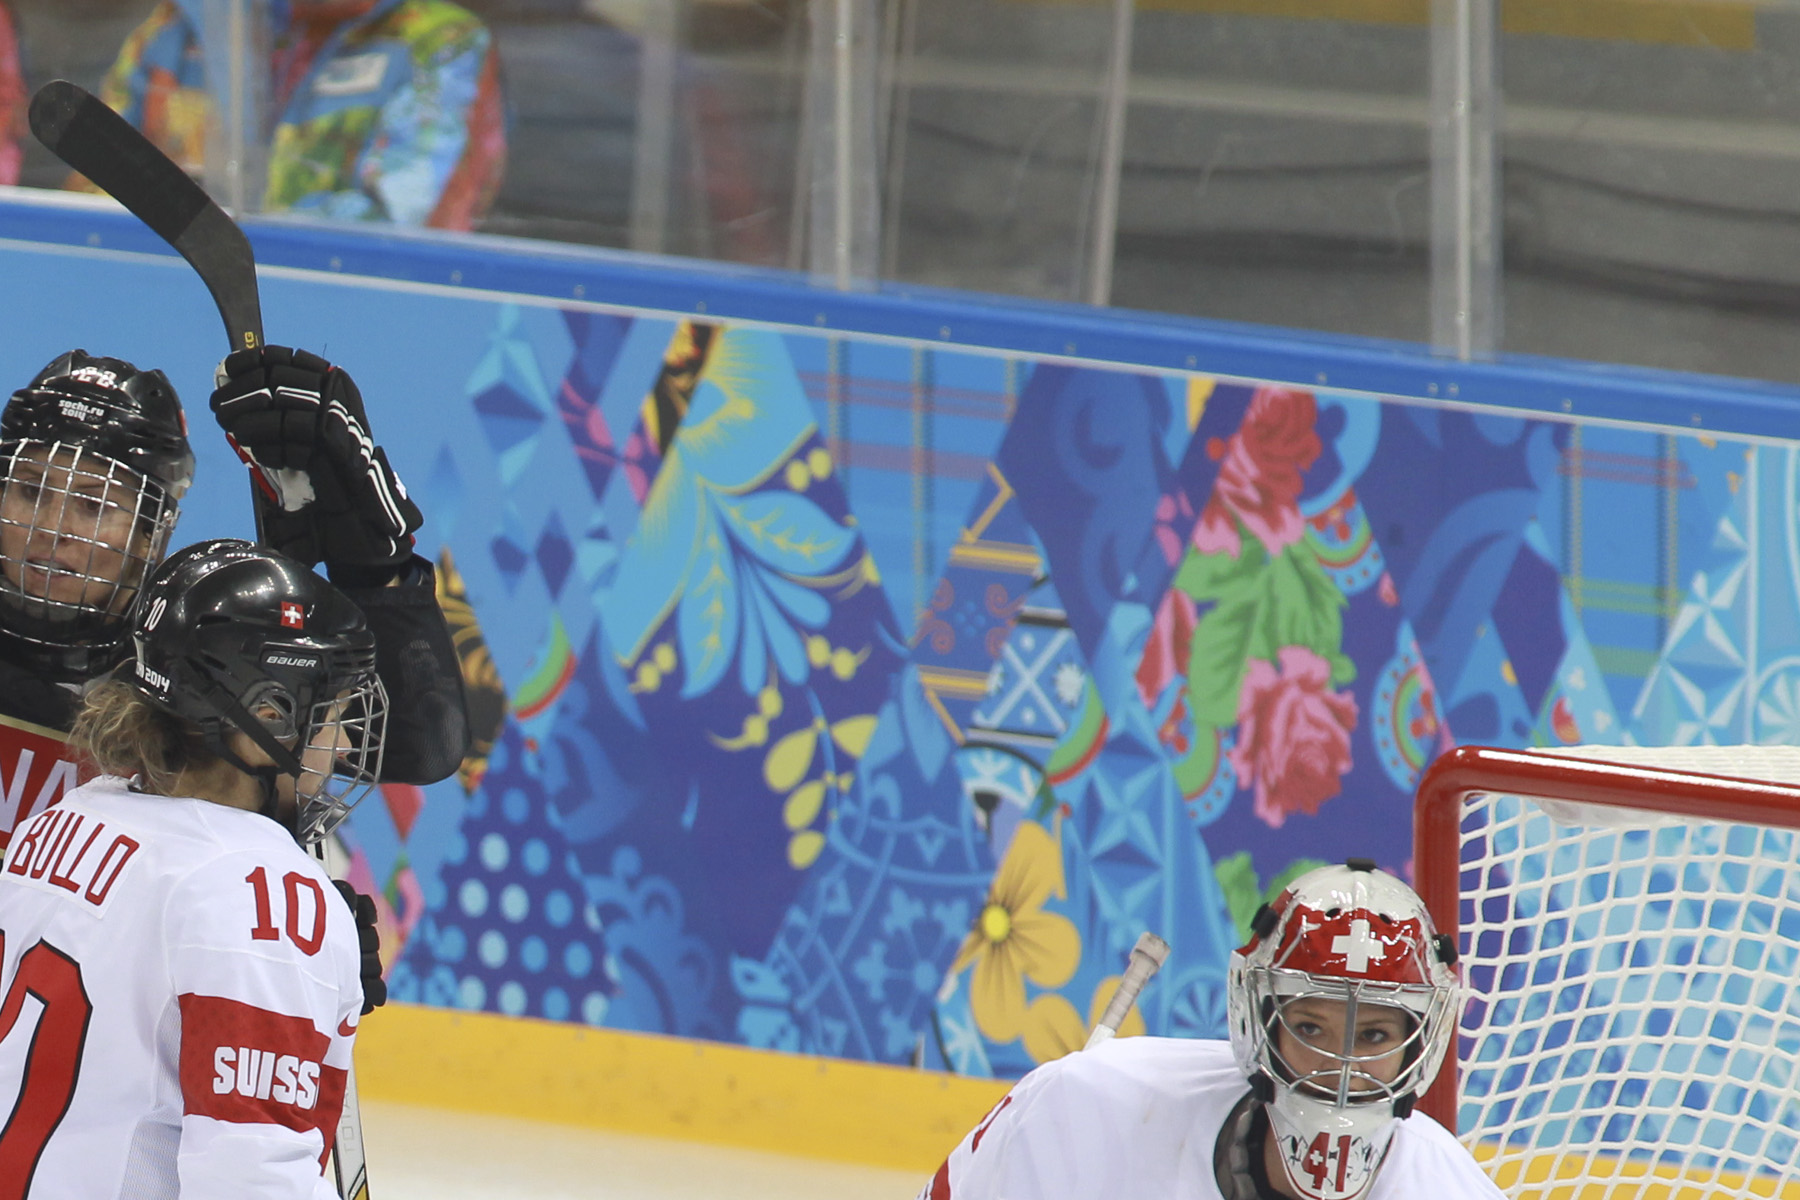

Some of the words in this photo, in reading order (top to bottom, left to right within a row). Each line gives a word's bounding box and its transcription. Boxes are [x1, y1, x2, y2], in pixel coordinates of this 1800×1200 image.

[58, 399, 104, 418] sochi.ru
[61, 407, 86, 421] 2014
[144, 596, 167, 631] 10
[266, 654, 317, 668] BAUER
[7, 810, 140, 906] BULLO
[245, 866, 327, 957] 10
[212, 1046, 321, 1110] SUISS
[1301, 1131, 1352, 1192] 41
